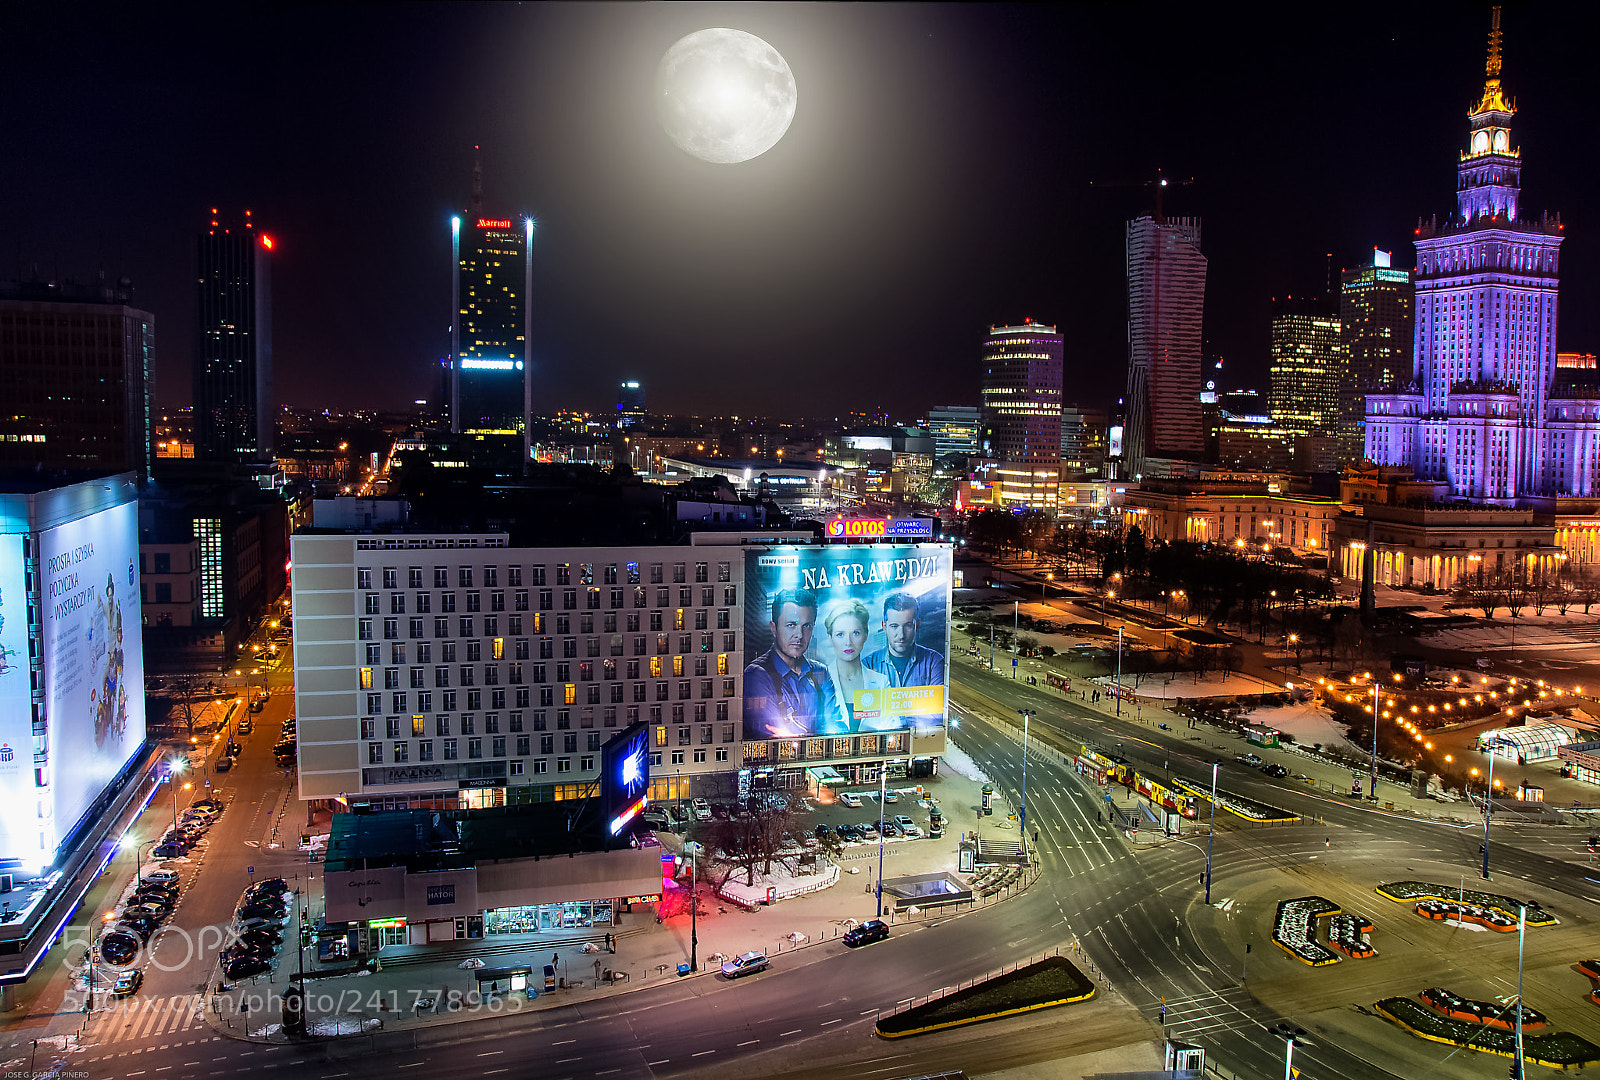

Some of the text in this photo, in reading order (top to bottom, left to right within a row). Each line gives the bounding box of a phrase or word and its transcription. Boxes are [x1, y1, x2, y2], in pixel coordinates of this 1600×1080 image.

[476, 218, 512, 229] Marriott
[845, 520, 885, 535] LOTOS
[48, 552, 71, 576] PROSTA
[75, 542, 95, 564] SZYBKA
[802, 555, 938, 590] NA KRAWĘDZI
[54, 589, 87, 621] WYSTARCZY
[891, 689, 935, 700] CZWARTEK
[428, 891, 454, 899] HATOR
